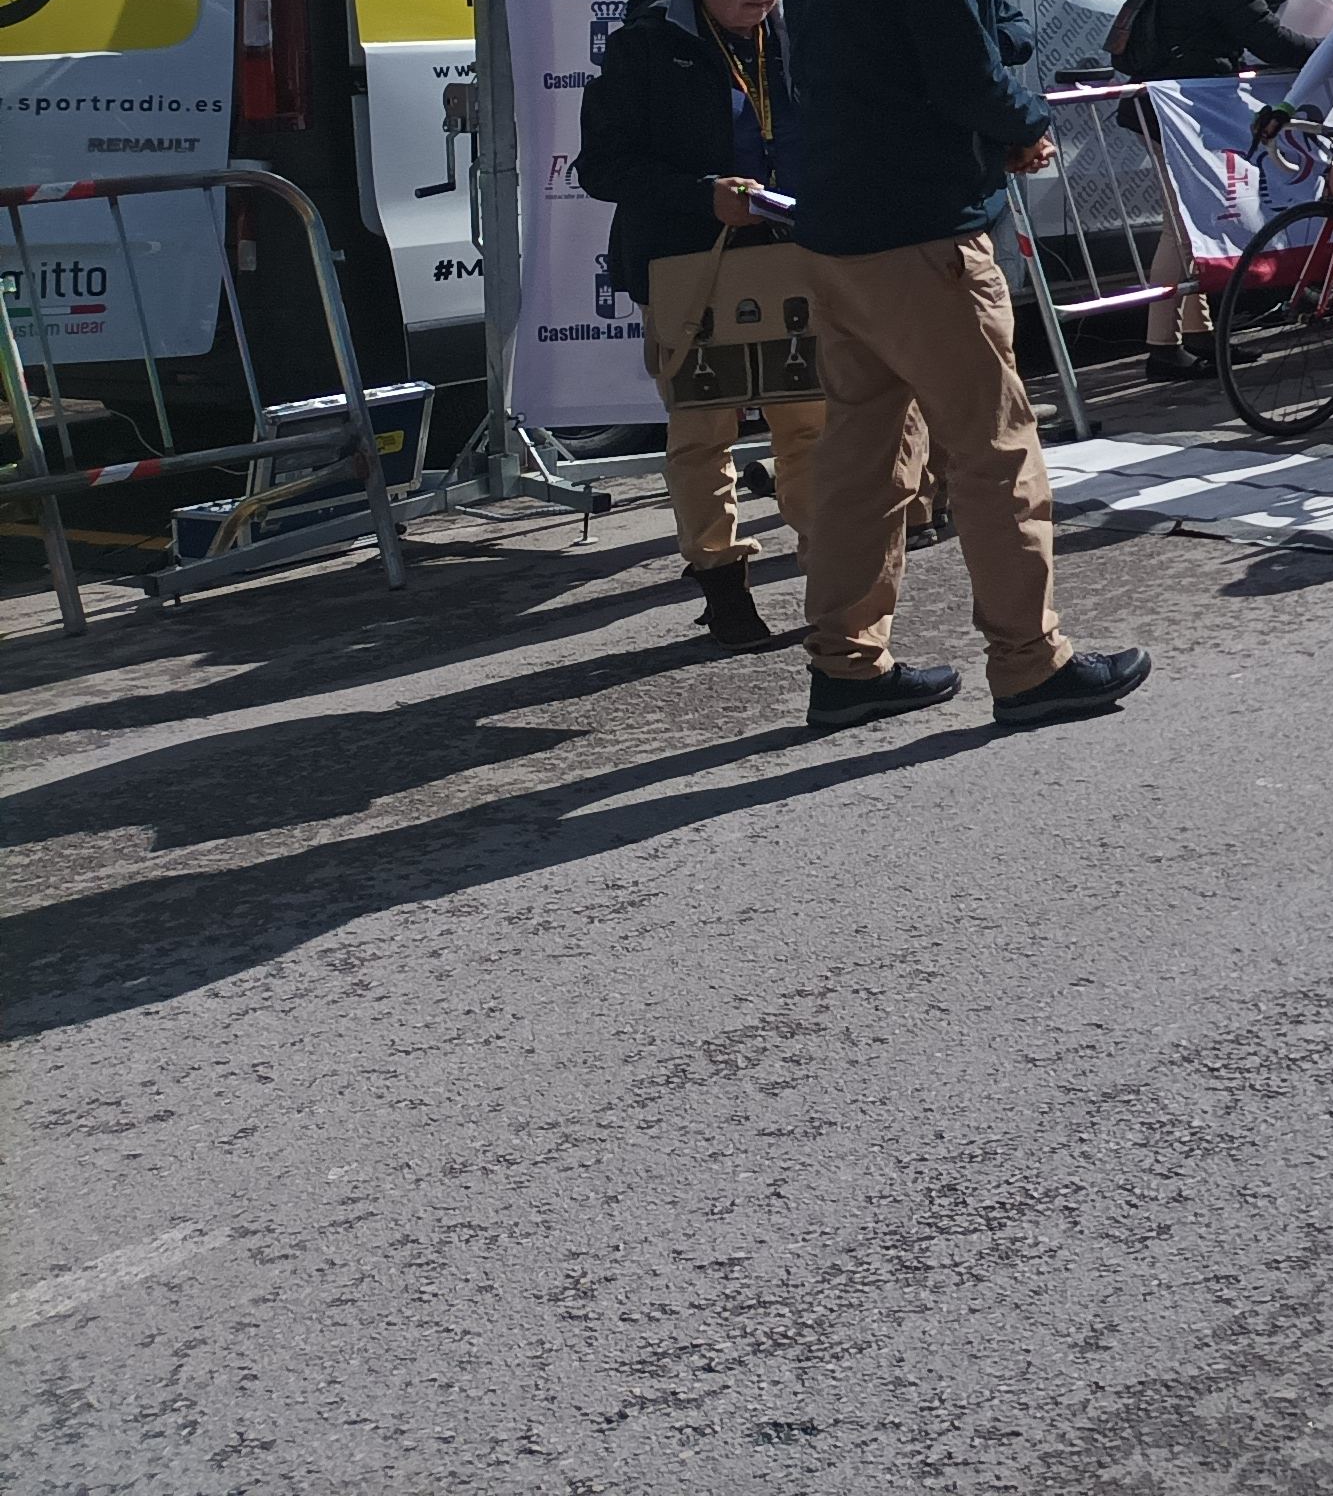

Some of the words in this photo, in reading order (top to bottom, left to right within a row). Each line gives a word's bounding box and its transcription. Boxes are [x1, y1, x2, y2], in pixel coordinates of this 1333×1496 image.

[0, 95, 223, 115] .sportradio.es
[88, 138, 200, 154] RENAULT
[65, 320, 106, 336] wear
[537, 322, 623, 342] Castilla-La
